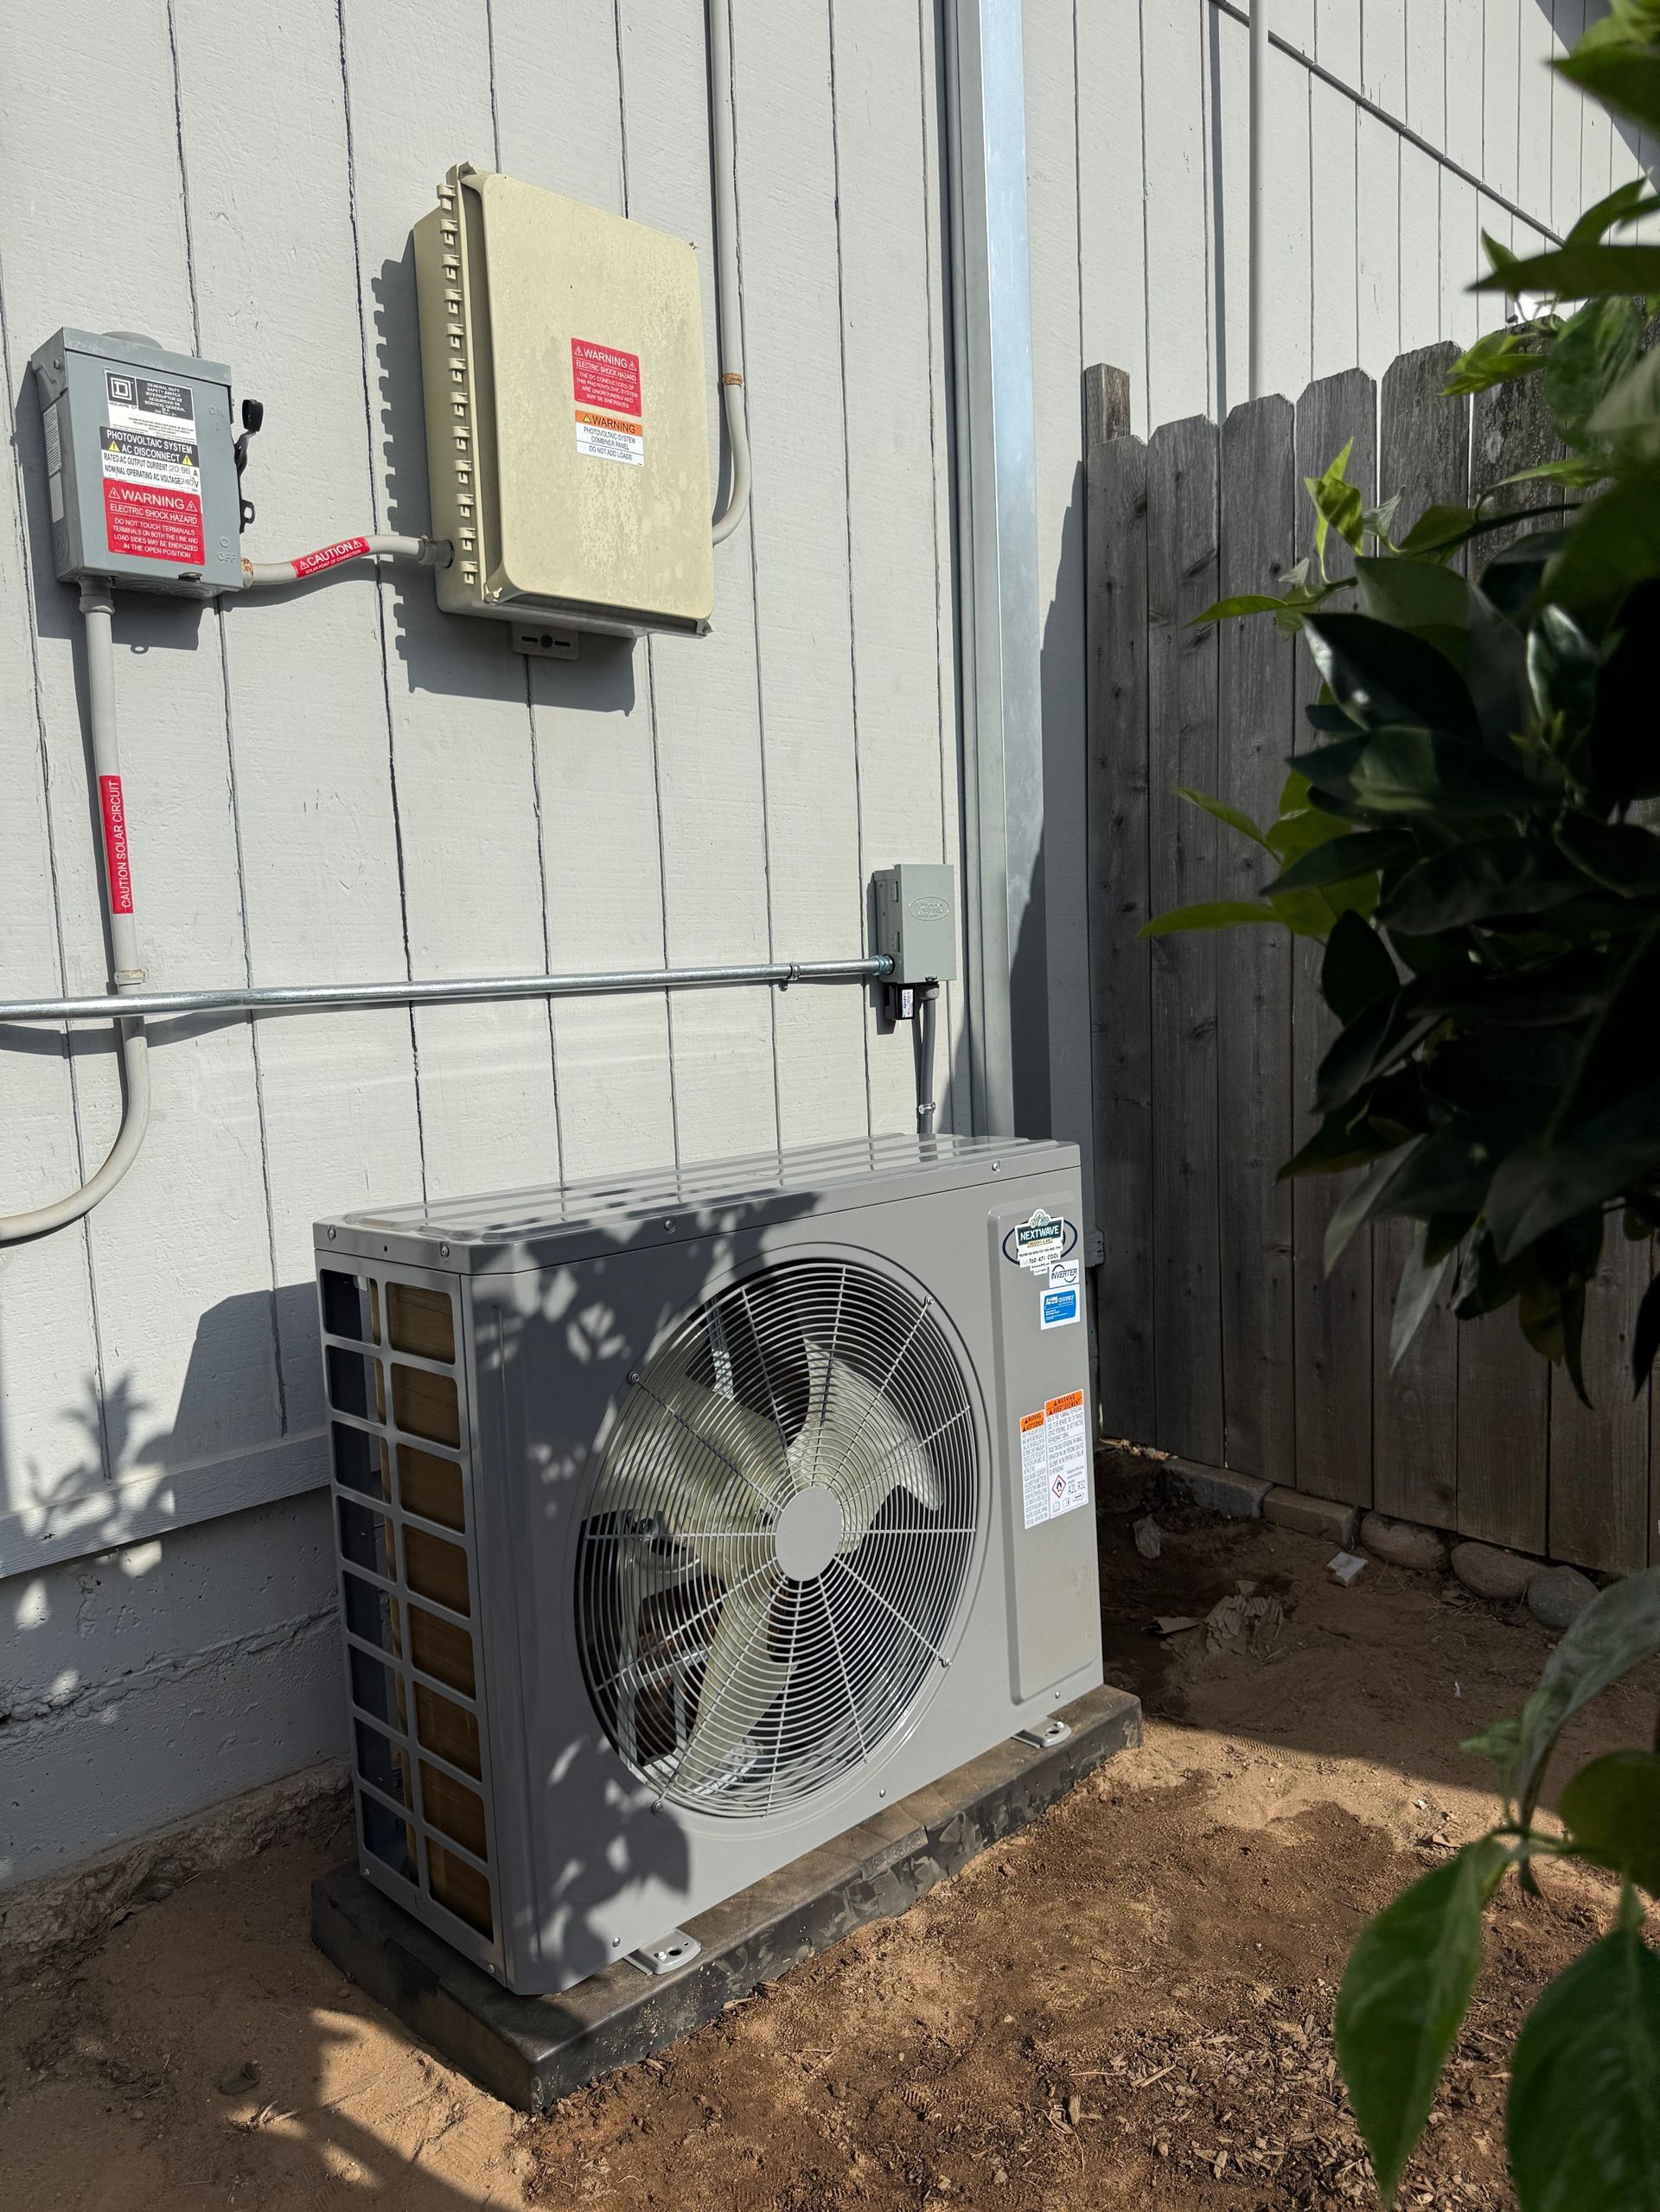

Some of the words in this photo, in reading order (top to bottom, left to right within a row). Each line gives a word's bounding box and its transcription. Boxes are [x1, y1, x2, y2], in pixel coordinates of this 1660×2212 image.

[584, 347, 628, 368] WARNING
[576, 360, 600, 372] ELECTRIC
[600, 366, 617, 376] SHOCK
[617, 371, 636, 382] HAZARD
[588, 380, 620, 393] PHOTOVOLTAIC
[621, 388, 638, 398] SYSTEM
[597, 376, 627, 389] CONDUCTORS
[146, 392, 176, 402] INTERRUPTOR
[149, 397, 174, 405] SEGURIDAD
[592, 415, 635, 433] WARNING
[107, 429, 162, 448] PHOTOVOLTAIC
[163, 441, 192, 454] SYSTEM
[584, 427, 617, 440] PHOTOVOLTAIC
[618, 434, 635, 443] SYSTEM
[591, 436, 615, 447] COMBINER
[616, 442, 629, 450] PANEL
[121, 444, 132, 454] AC
[134, 446, 180, 463] DISCONNECT
[617, 452, 632, 460] LOADS
[104, 453, 119, 462] RATED
[128, 457, 146, 467] OUTPUT
[147, 461, 168, 472] CURRENT
[105, 465, 126, 475] NOMINAL
[127, 468, 153, 479] OPERATING
[161, 475, 181, 484] VOLTAGE
[181, 478, 193, 486] 240
[194, 480, 198, 488] V
[121, 489, 184, 509] WARNING
[110, 504, 144, 516] ELECTRIC
[145, 509, 168, 520] SHOCK
[170, 513, 197, 524] HAZARD
[113, 526, 141, 535] TERMINALS
[140, 521, 160, 529] TOUCH
[162, 525, 195, 535] TERMINALS
[163, 548, 191, 558] POSITION
[169, 542, 198, 551] ENERGIZED
[307, 542, 353, 566] CAUTION
[217, 552, 236, 563] OFF
[336, 550, 361, 561] CONNECTION
[109, 781, 122, 822] CIRCUIT
[114, 825, 126, 860] SOLAR
[118, 863, 131, 908] CAUTION
[1020, 1225, 1059, 1241] NEXTWAVE
[1051, 1268, 1077, 1279] INVERTER
[1058, 1393, 1075, 1404] WARNING
